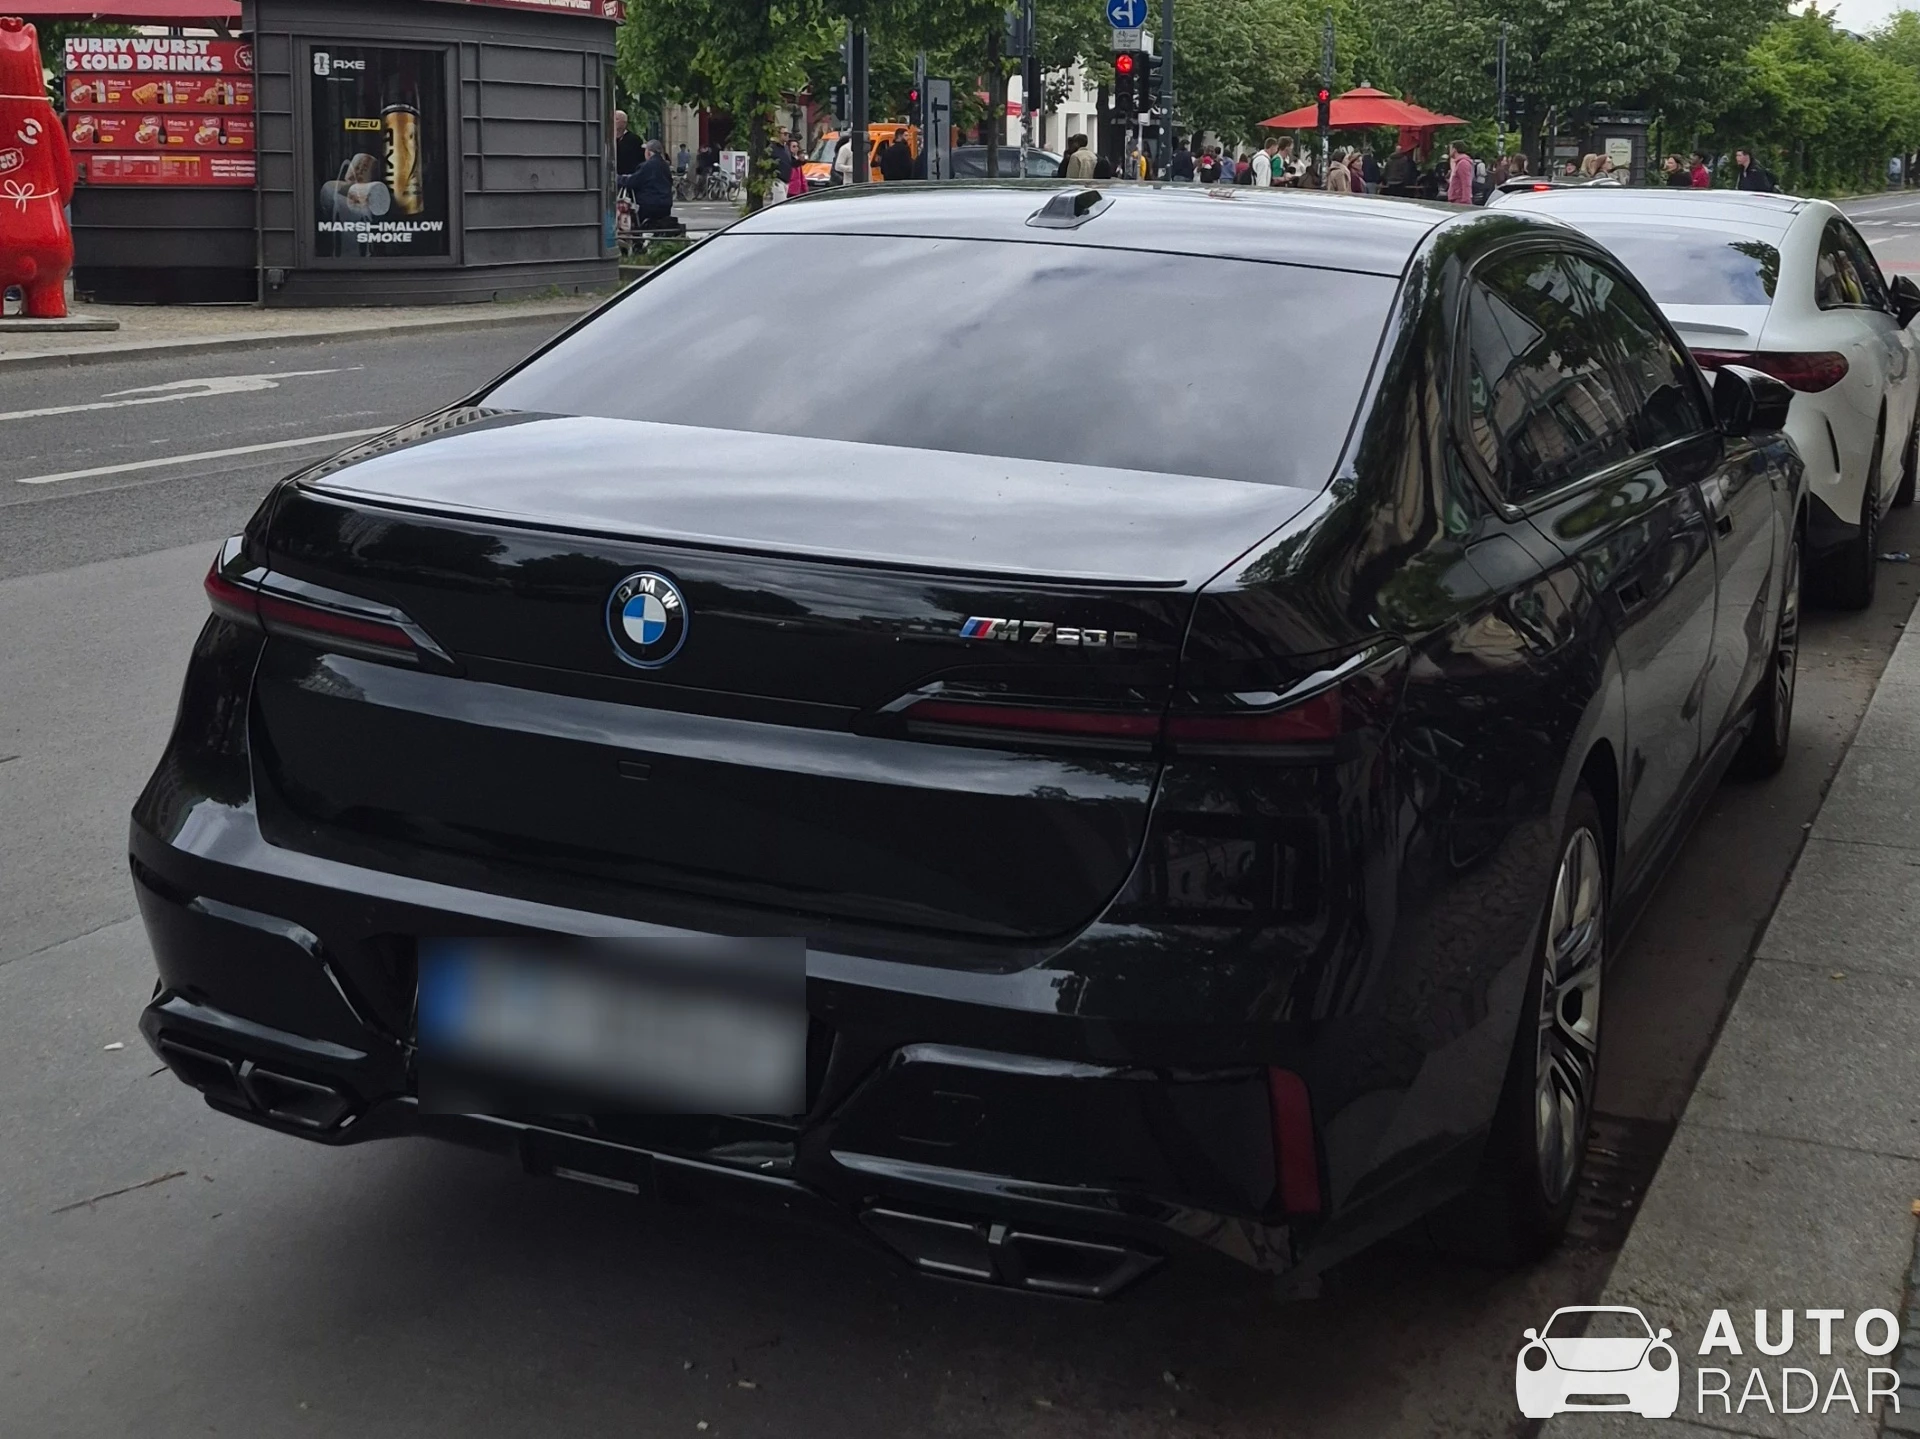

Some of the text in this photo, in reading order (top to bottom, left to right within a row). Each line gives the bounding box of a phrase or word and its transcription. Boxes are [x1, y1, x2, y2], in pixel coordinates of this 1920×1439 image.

[65, 38, 210, 54] CURRYWURST
[66, 54, 223, 72] & COLD DRINKS
[333, 60, 366, 70] AXE
[347, 120, 379, 129] NEU
[318, 221, 443, 232] MARSHMALLOW
[356, 232, 412, 243] SMOKE
[617, 578, 679, 609] BMW
